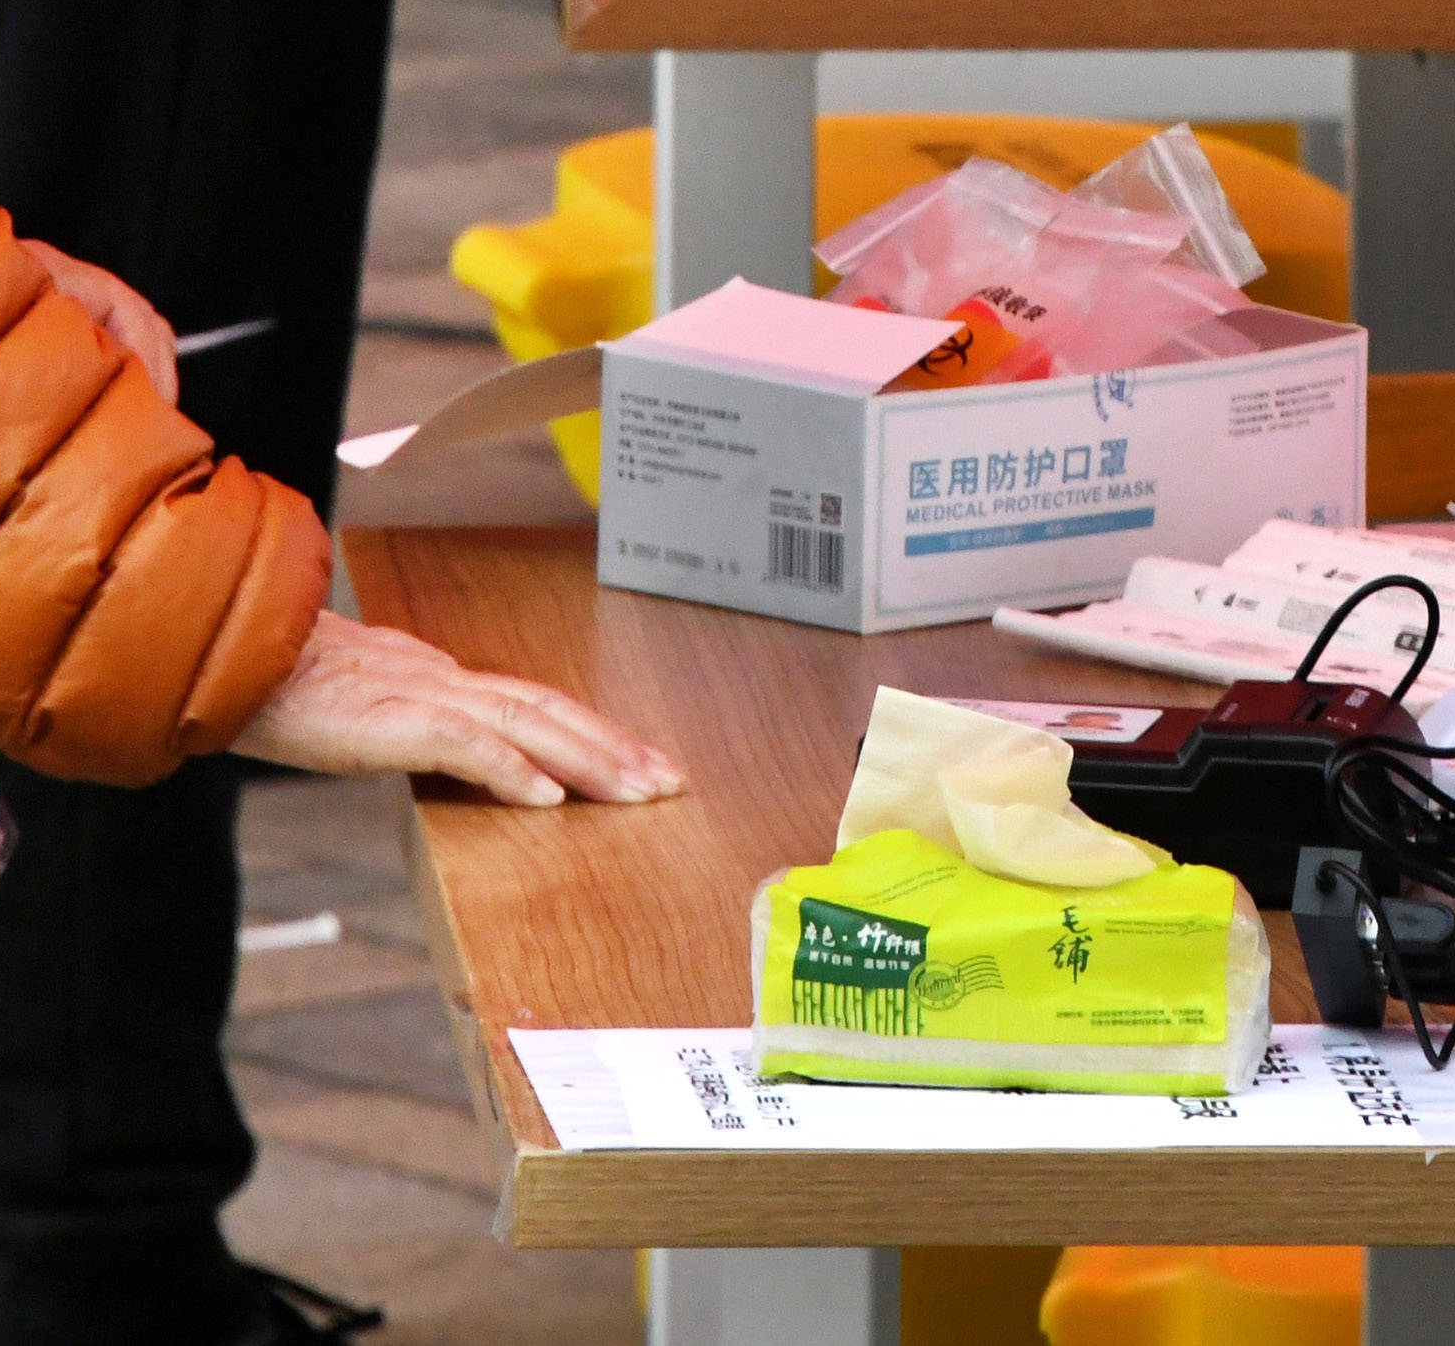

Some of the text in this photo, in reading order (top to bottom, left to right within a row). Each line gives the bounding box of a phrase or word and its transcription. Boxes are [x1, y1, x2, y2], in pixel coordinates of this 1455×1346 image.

[909, 438, 1129, 500] 医用防护口罩
[906, 479, 1158, 523] MEDICAL PROTECTIVE MASK
